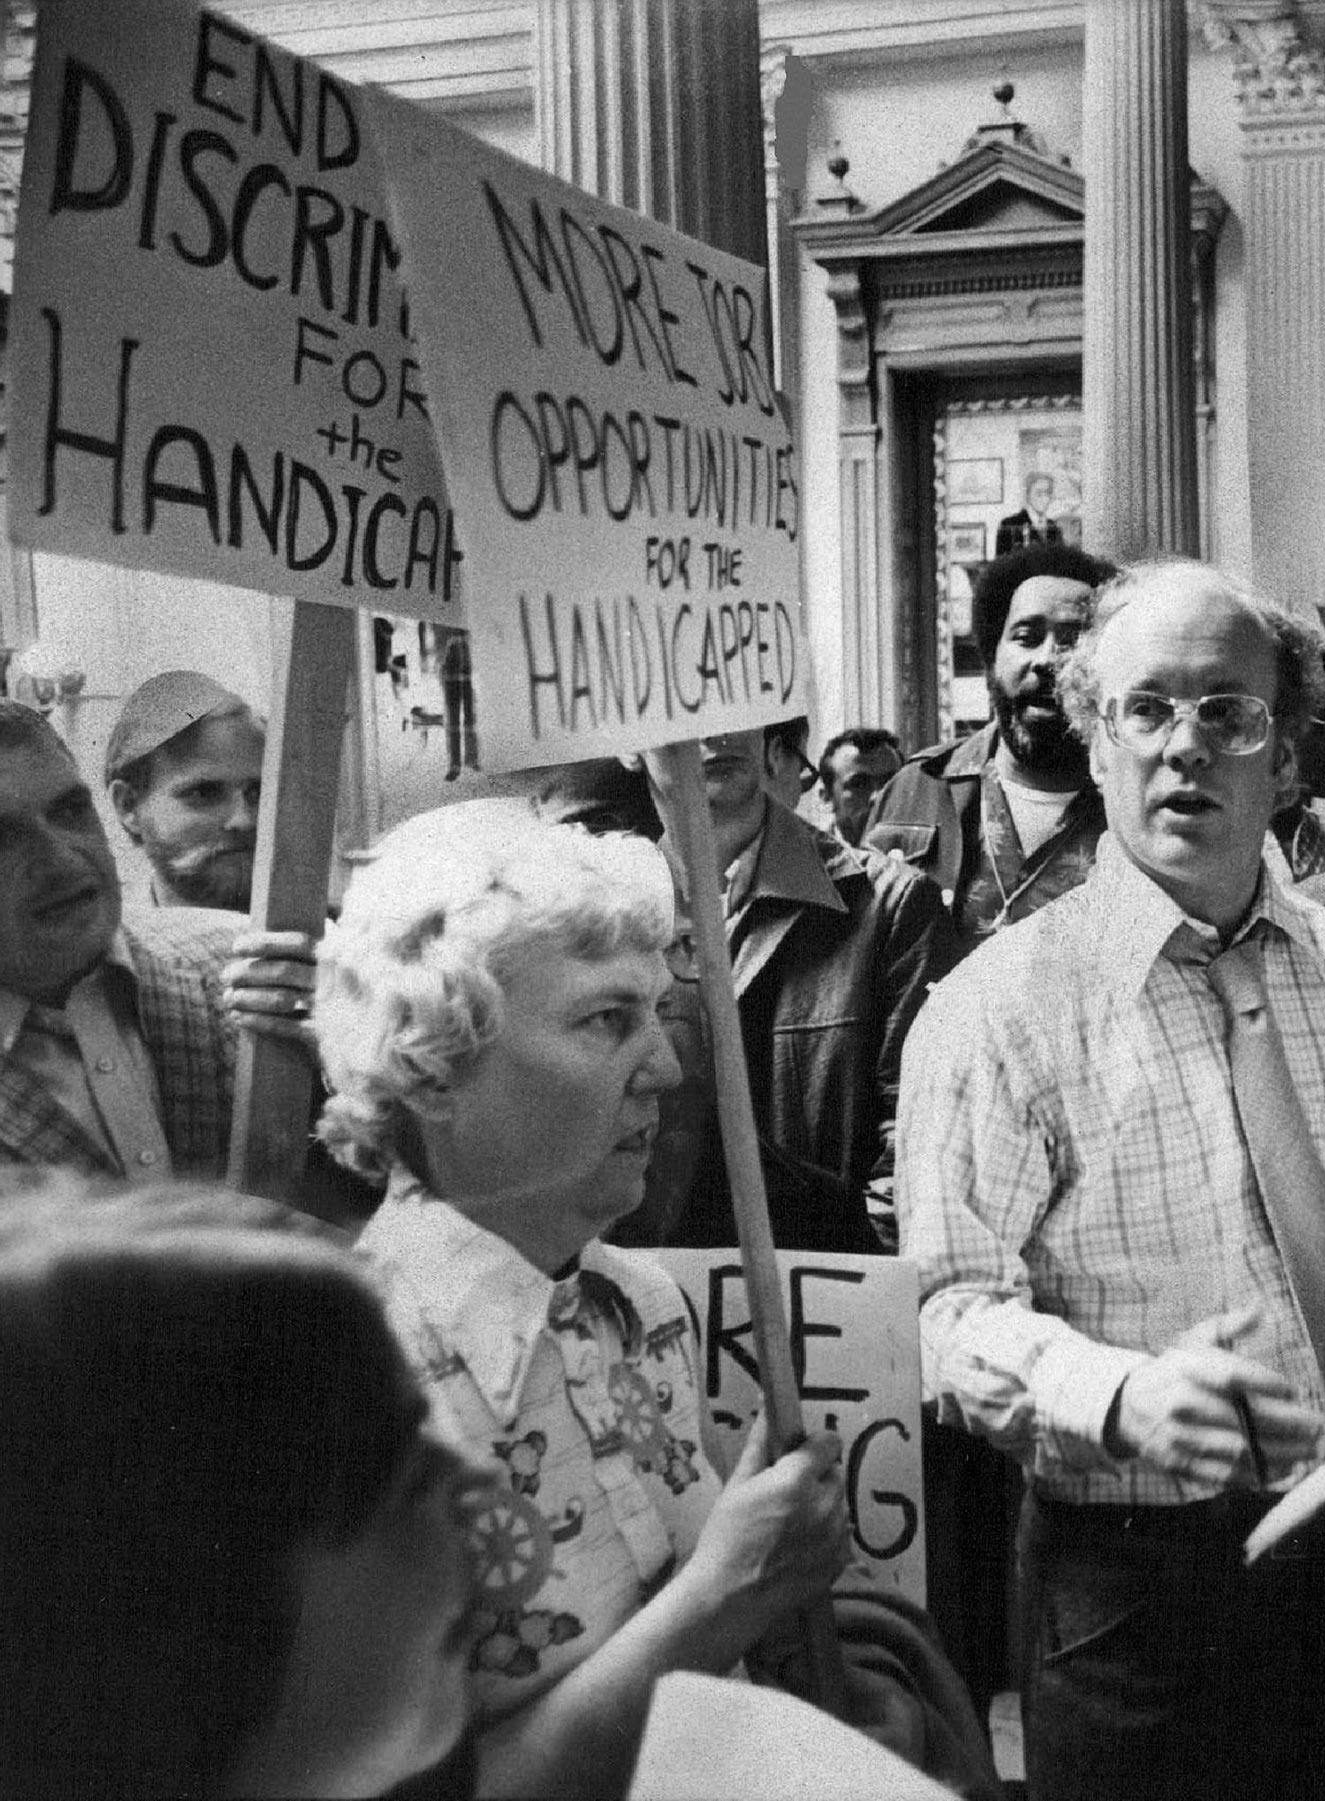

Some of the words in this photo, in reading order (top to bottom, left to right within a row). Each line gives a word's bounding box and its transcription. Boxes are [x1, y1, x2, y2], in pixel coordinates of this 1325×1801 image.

[192, 12, 360, 172] END
[482, 180, 698, 388] MORE
[293, 316, 430, 419] FOR
[317, 413, 402, 483] the
[491, 391, 798, 542] OPPORTUNITIES
[645, 535, 691, 592] FOR
[702, 541, 742, 590] THE
[520, 594, 796, 741] HANDICAPPED
[679, 1264, 870, 1402] RE
